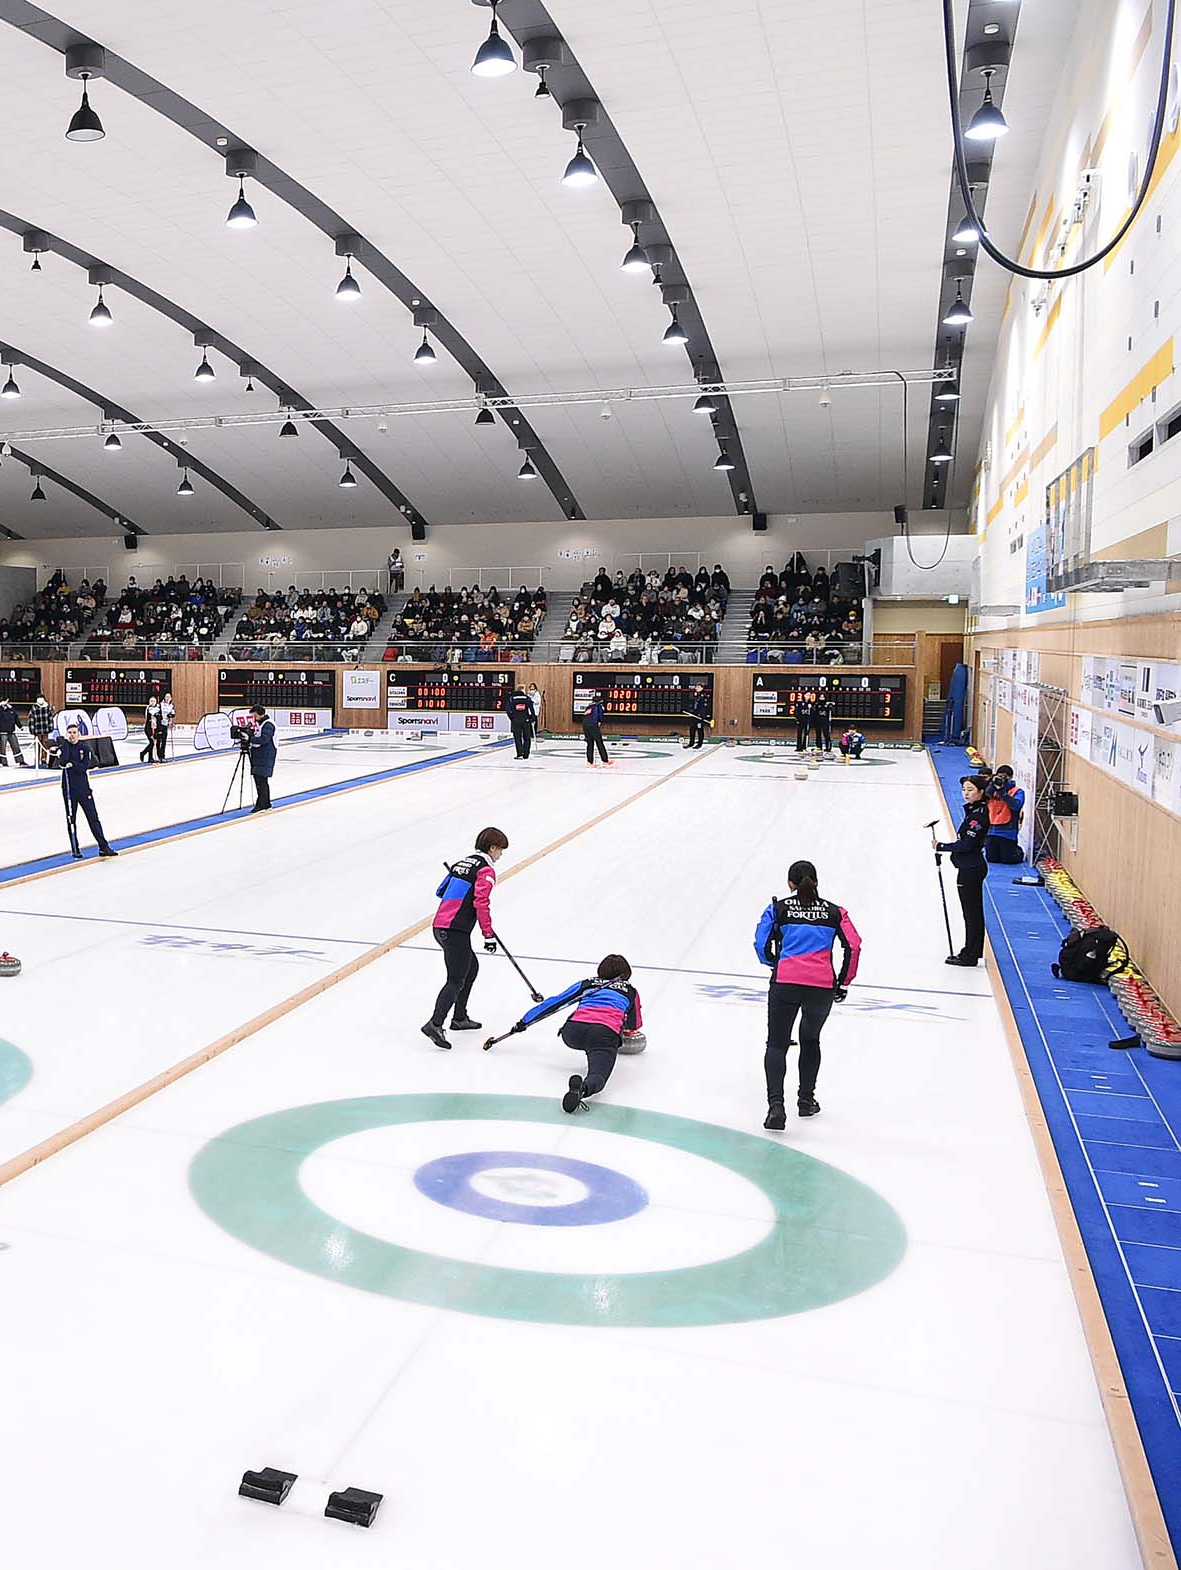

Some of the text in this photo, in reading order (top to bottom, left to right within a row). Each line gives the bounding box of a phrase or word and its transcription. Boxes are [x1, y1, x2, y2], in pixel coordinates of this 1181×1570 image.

[389, 674, 396, 682] C
[442, 674, 508, 683] 0 0 51
[576, 675, 583, 684] B
[634, 675, 679, 685] 0 0
[756, 676, 764, 687] A
[819, 676, 868, 688] 0 0
[884, 694, 891, 703] 3
[884, 707, 891, 716] 3
[787, 910, 829, 921] FORTIUS
